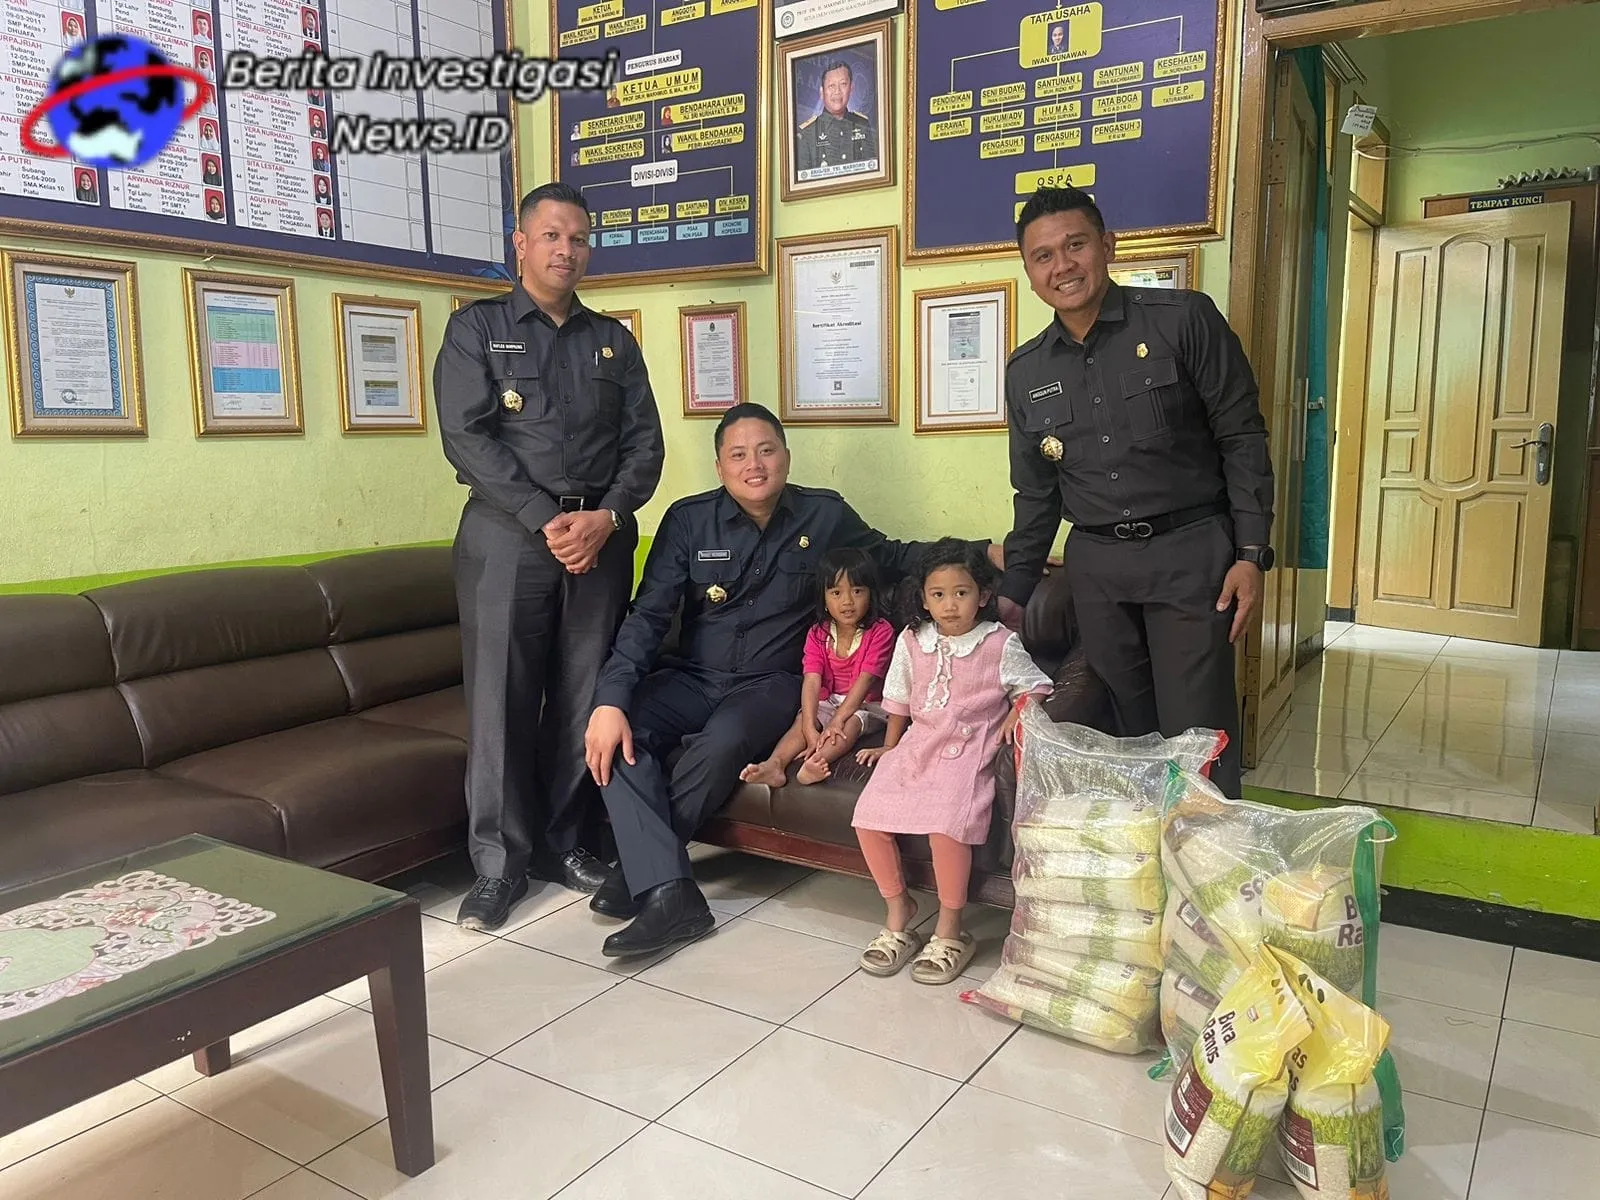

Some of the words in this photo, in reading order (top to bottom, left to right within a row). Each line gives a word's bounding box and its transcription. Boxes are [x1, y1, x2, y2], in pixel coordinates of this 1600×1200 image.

[592, 4, 612, 15] KETUA
[671, 5, 697, 17] ANGGOTA
[1030, 13, 1054, 25] TATA
[1055, 5, 1091, 20] USAHA
[7, 27, 36, 38] DHUAFA
[10, 45, 35, 56] Subang
[1051, 50, 1088, 62] GUNAWAN
[627, 58, 658, 70] PENGURUS
[657, 54, 681, 65] HARIAN
[1157, 52, 1205, 70] KESEHATAN
[1098, 64, 1141, 79] SANTUNAN
[622, 79, 659, 95] KETUA
[665, 71, 700, 87] UMUM
[998, 83, 1026, 95] BUDAYA
[1036, 75, 1076, 90] SANTUNAN
[679, 99, 722, 114] BENDAHARA
[722, 95, 744, 106] UMUM
[932, 92, 972, 106] PENDIDIKAN
[1116, 93, 1138, 104] BOGA
[1041, 103, 1075, 116] HUMAS
[587, 115, 624, 130] SEKRETARIS
[624, 112, 644, 124] UMUM
[935, 119, 966, 132] PERAWAT
[699, 126, 743, 140] BENDAHARA
[1094, 123, 1135, 135] PENGASUH
[1036, 131, 1075, 144] PENGASUH
[584, 147, 604, 158] WAKIL
[604, 140, 643, 154] SEKRETARIS
[982, 139, 1019, 151] PENGASUH
[633, 168, 676, 181] DIVISI-DIVISI
[1036, 173, 1074, 187] OSPA
[1469, 198, 1510, 210] TEMPAT
[1511, 195, 1544, 207] KUNCI
